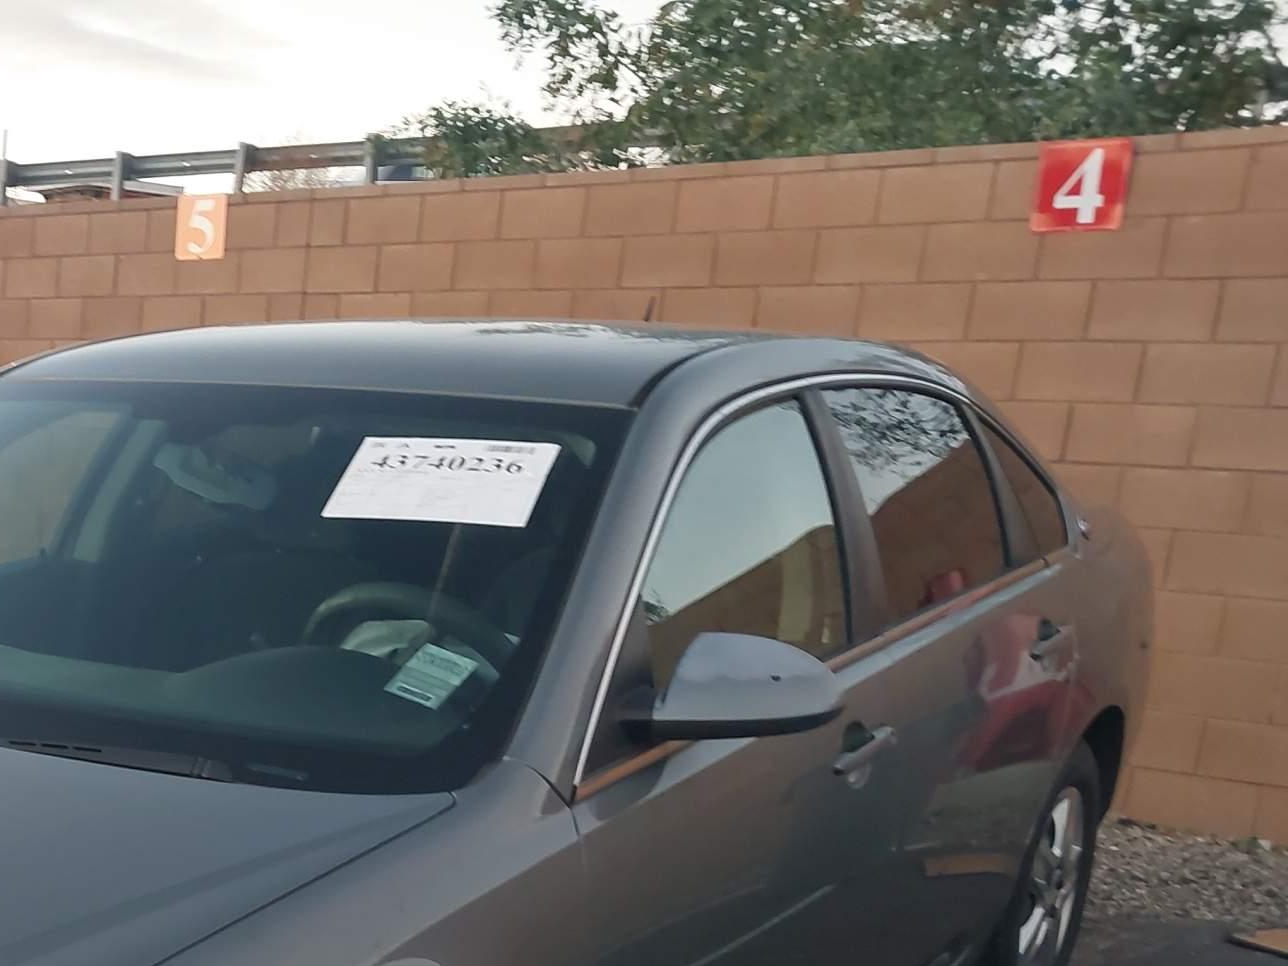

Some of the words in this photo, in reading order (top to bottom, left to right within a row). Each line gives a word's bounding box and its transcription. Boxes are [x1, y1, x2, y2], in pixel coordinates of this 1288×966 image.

[1053, 148, 1105, 224] 4
[187, 199, 216, 254] 5
[370, 454, 524, 475] 43740236
